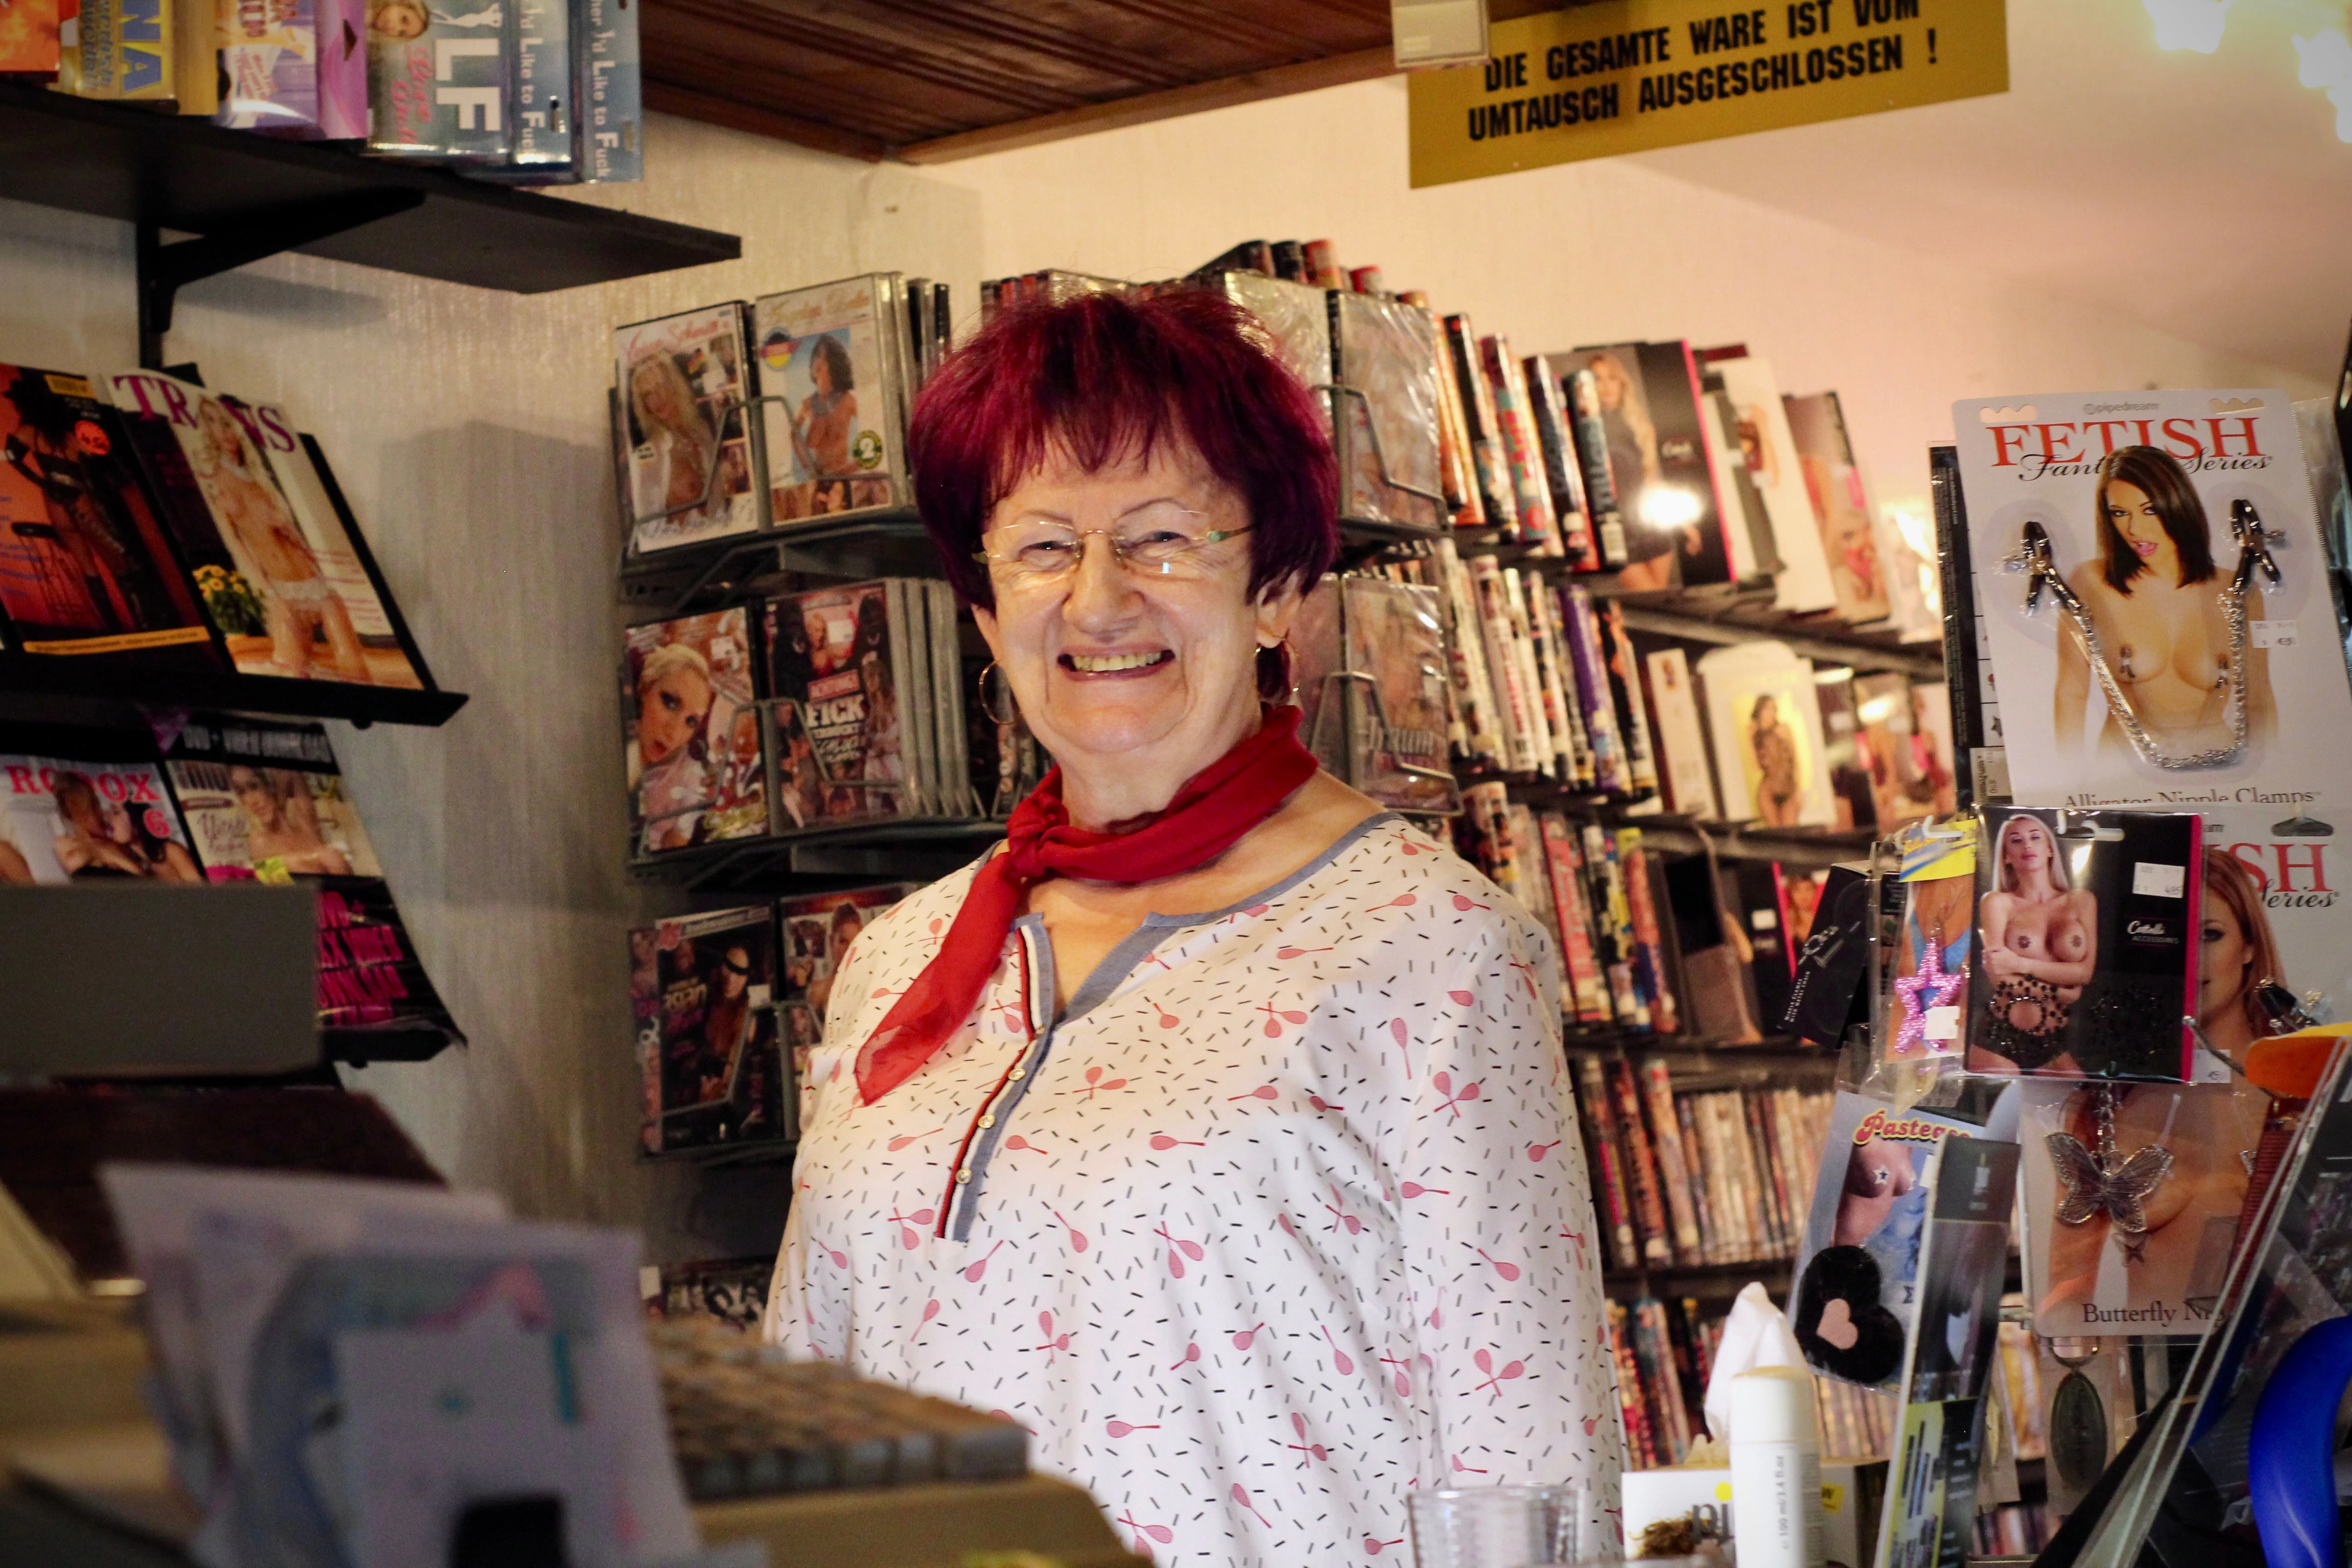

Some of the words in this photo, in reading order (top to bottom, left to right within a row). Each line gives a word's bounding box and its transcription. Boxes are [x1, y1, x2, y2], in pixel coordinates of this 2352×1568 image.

[1485, 52, 1528, 92] DIE
[1546, 26, 1670, 81] GESAMTE
[1689, 9, 1766, 55] WARE
[1788, 0, 1832, 39] IST
[1853, 0, 1919, 27] VOM
[592, 60, 616, 101] Like
[1468, 83, 1619, 141] UMTAUSCH
[1638, 34, 1903, 113] AUSGESCHLOSSEN
[593, 106, 607, 126] to
[594, 132, 619, 178] Fuck
[113, 375, 295, 452] TRNS
[1986, 417, 2267, 466] FETISH
[2019, 454, 2107, 481] Fant
[2183, 446, 2269, 475] Series
[5, 765, 162, 802] ROOX
[143, 809, 171, 839] 6
[2082, 1300, 2177, 1327] Butterfly
